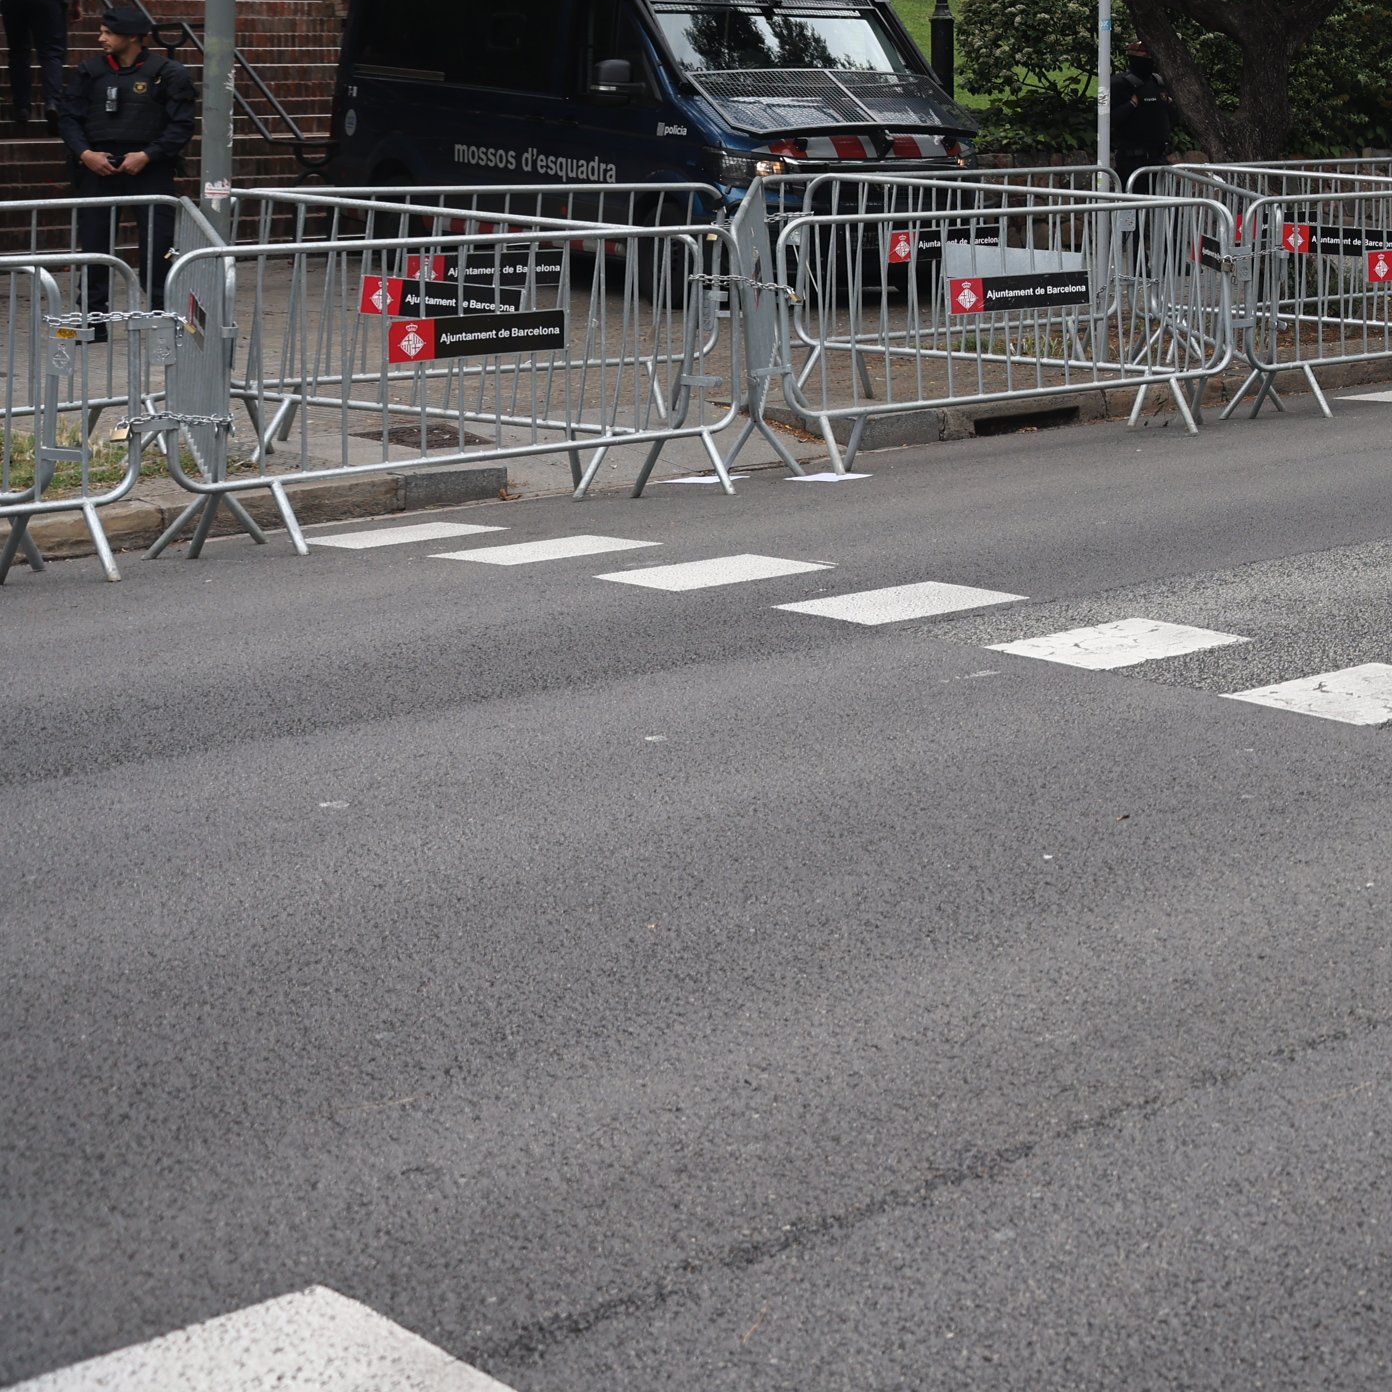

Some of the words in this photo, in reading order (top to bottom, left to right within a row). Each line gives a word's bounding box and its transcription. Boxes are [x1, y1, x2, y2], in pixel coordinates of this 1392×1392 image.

[664, 125, 687, 136] policia
[454, 143, 516, 170] mossos
[521, 147, 616, 183] d'esquadra
[1352, 238, 1362, 246] de
[502, 265, 514, 274] de
[986, 288, 1034, 300] Ajuntament
[1035, 287, 1045, 295] de
[1047, 284, 1087, 294] Barcelona
[469, 299, 516, 312] Barceona
[440, 329, 497, 344] Ajuntament
[498, 328, 510, 337] de
[511, 326, 560, 337] Barcelona
